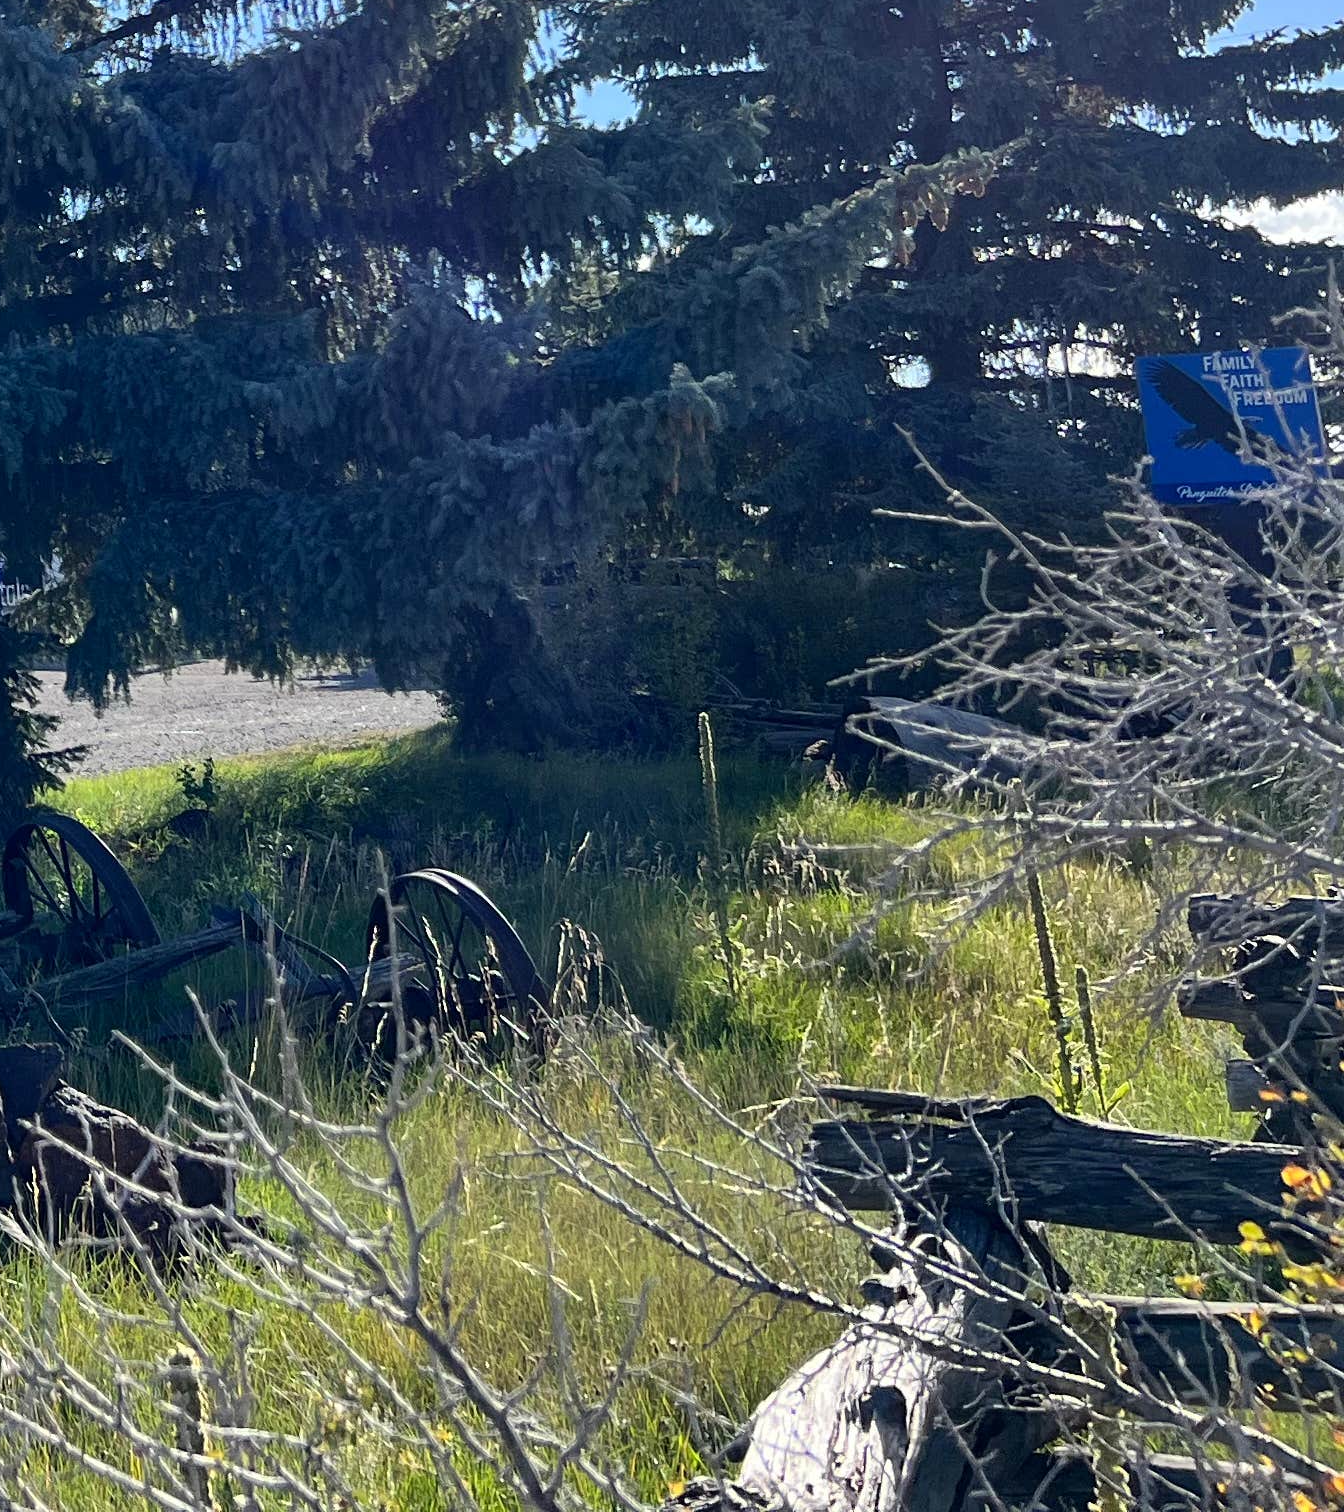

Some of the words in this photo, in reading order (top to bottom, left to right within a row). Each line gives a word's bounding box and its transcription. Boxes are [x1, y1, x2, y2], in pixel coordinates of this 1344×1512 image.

[1202, 355, 1255, 372] FAMILY
[1221, 374, 1265, 390] FAITH
[1176, 485, 1234, 502] Panguitch
